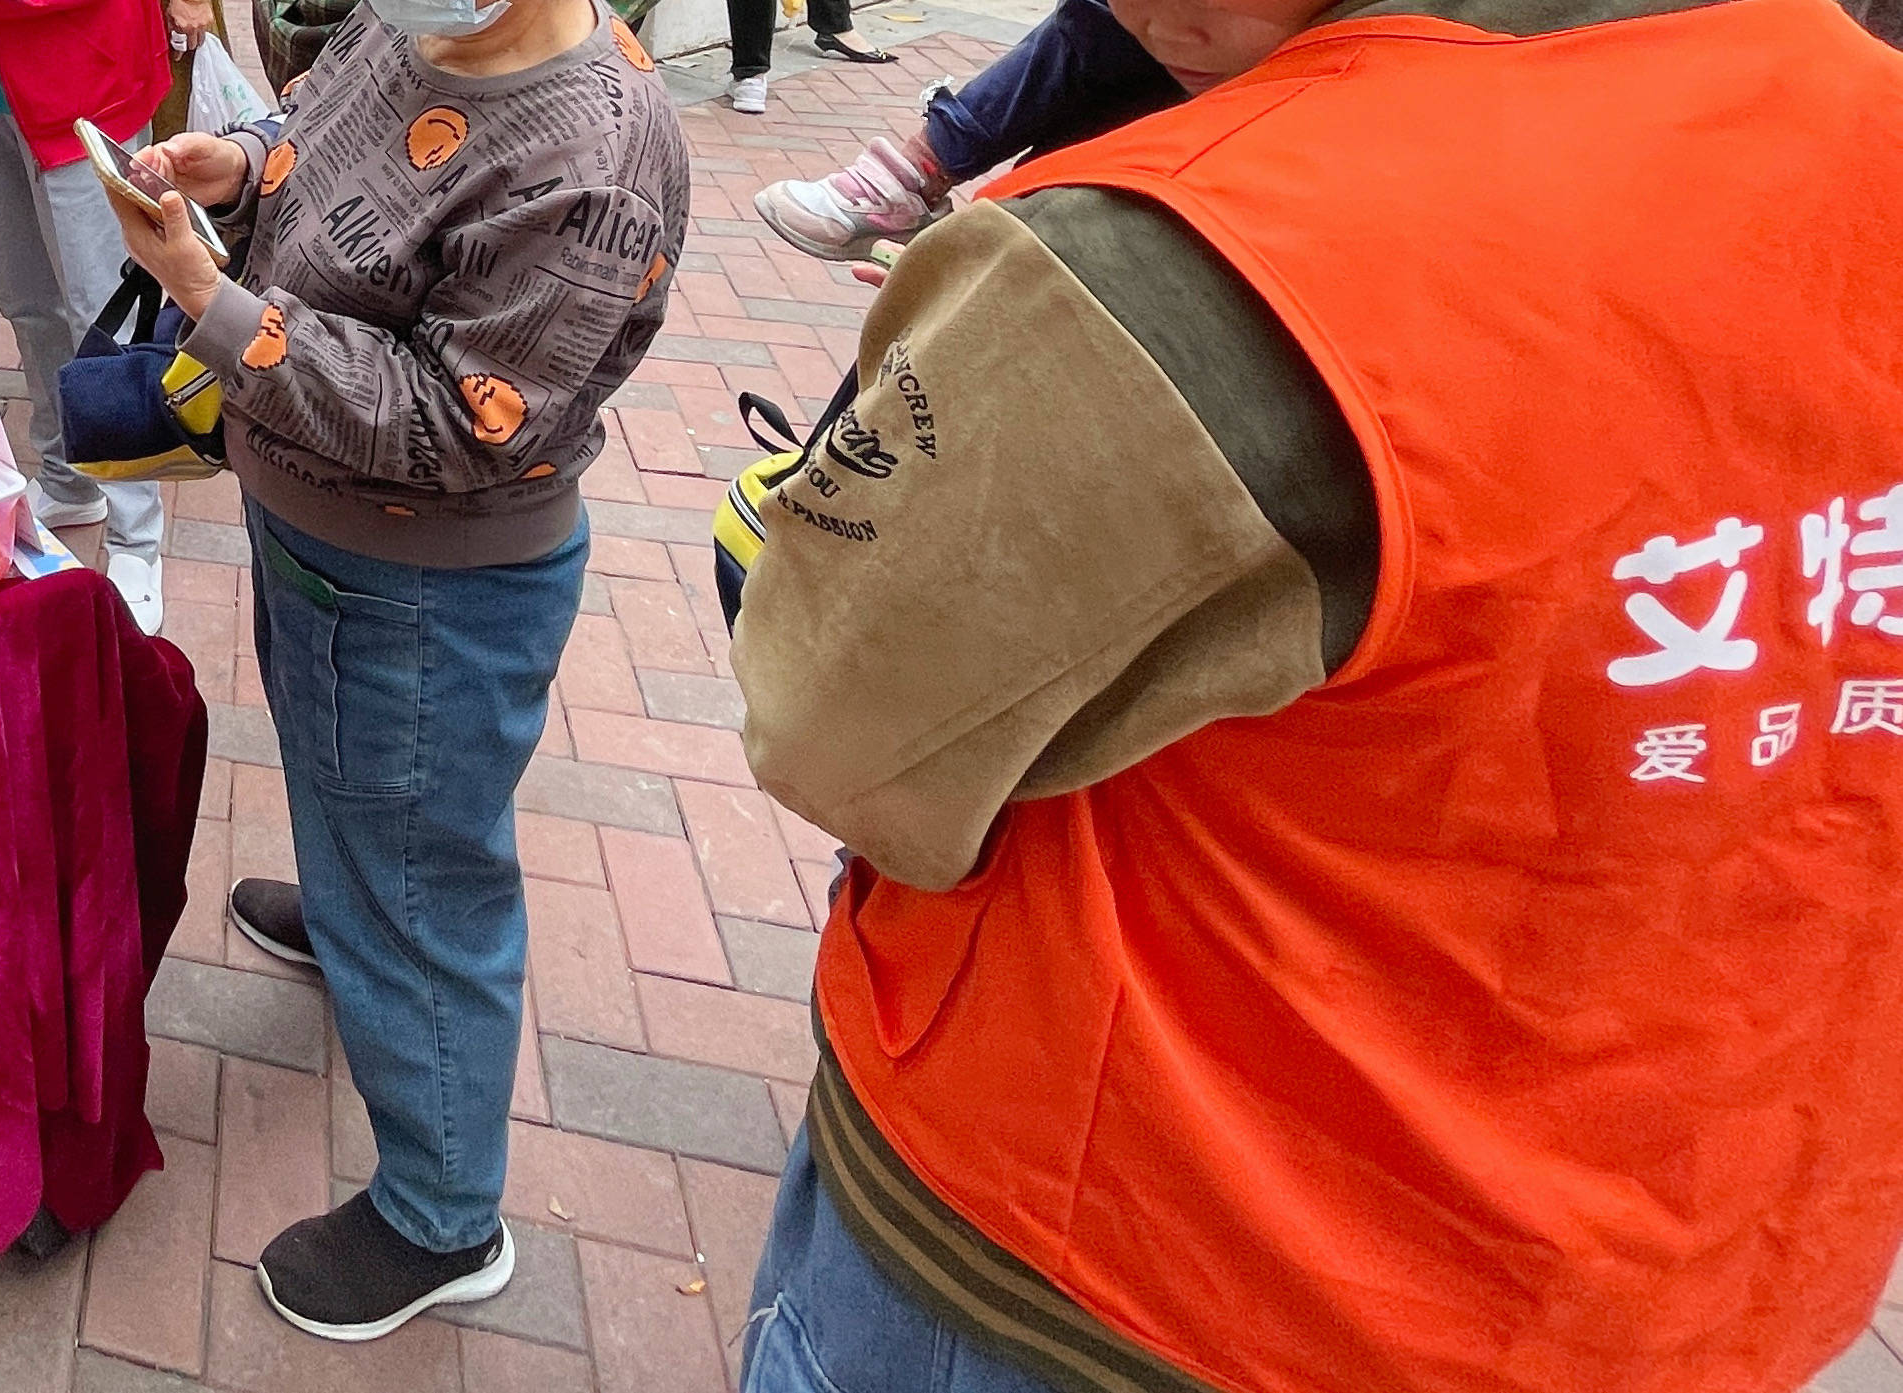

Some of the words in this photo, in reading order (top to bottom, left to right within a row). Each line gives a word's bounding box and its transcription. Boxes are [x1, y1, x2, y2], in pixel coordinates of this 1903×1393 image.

[320, 194, 414, 295] Alkicen
[1629, 678, 1903, 785] 爱品质
